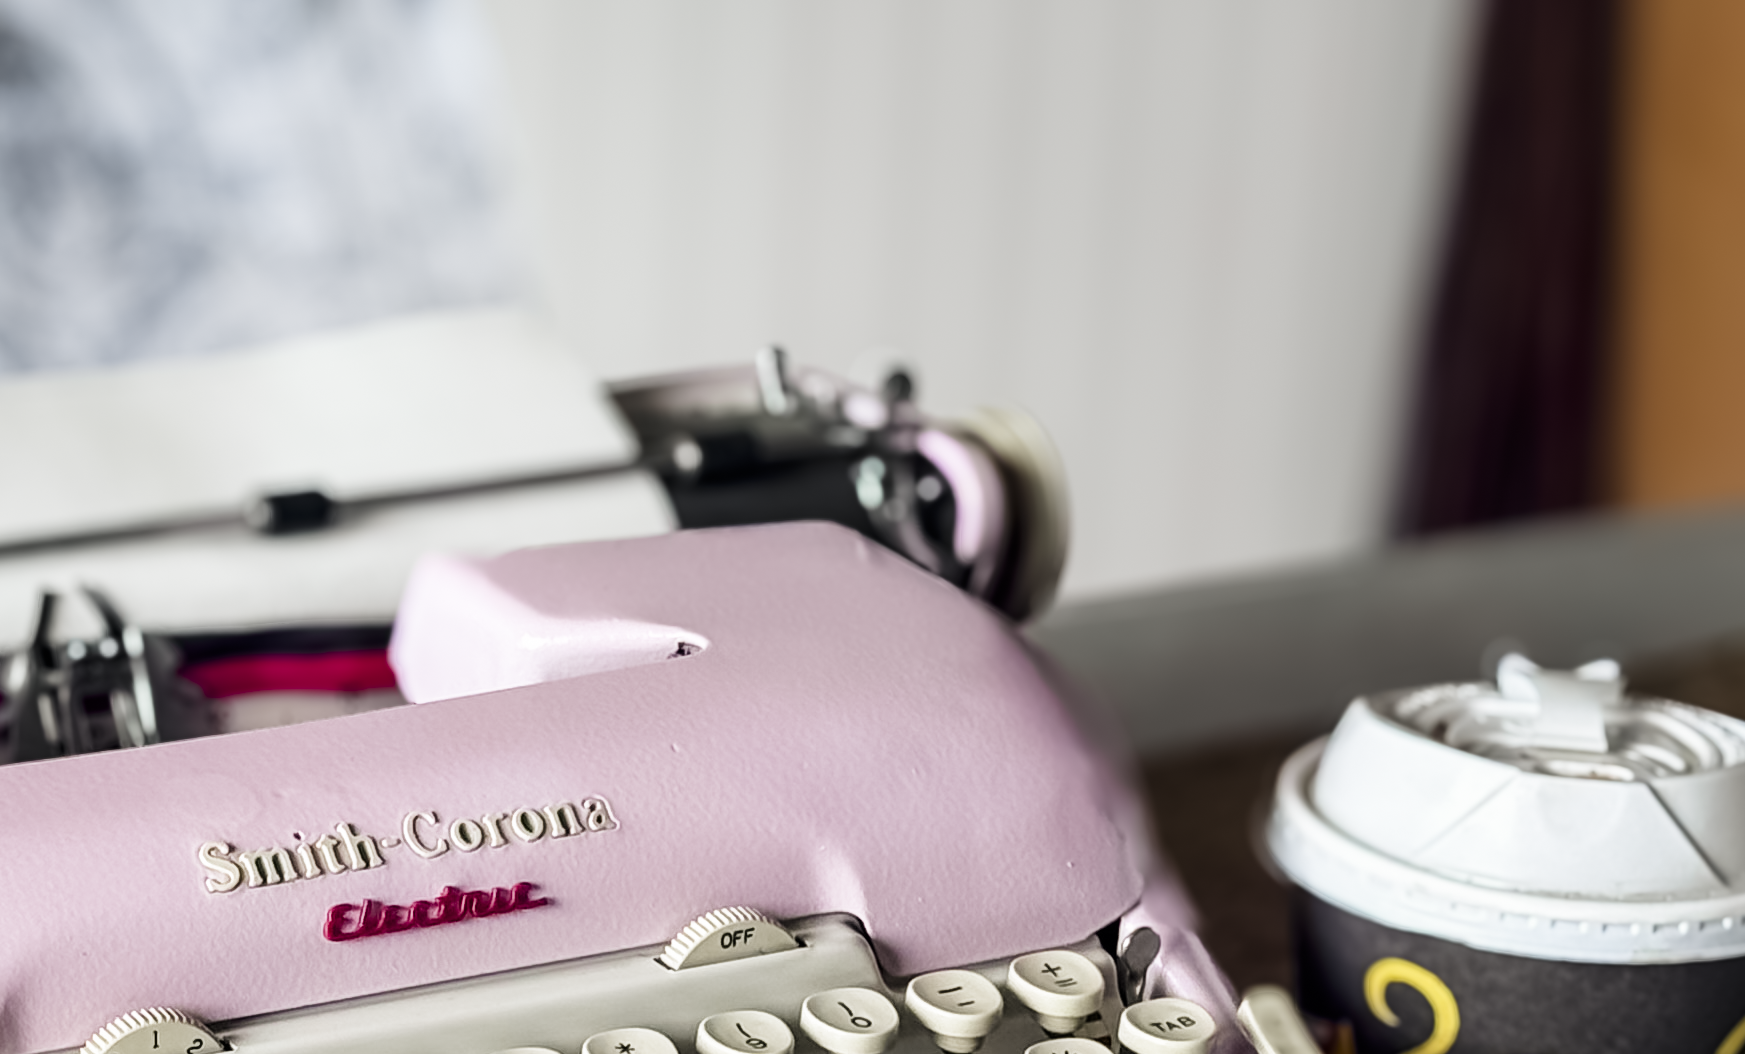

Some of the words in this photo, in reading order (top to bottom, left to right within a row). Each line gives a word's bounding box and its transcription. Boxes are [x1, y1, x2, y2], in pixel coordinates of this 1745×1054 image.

[197, 794, 620, 893] Smith-Corona
[323, 881, 548, 941] Electric
[720, 926, 755, 949] OFF
[1151, 1016, 1196, 1033] TAB
